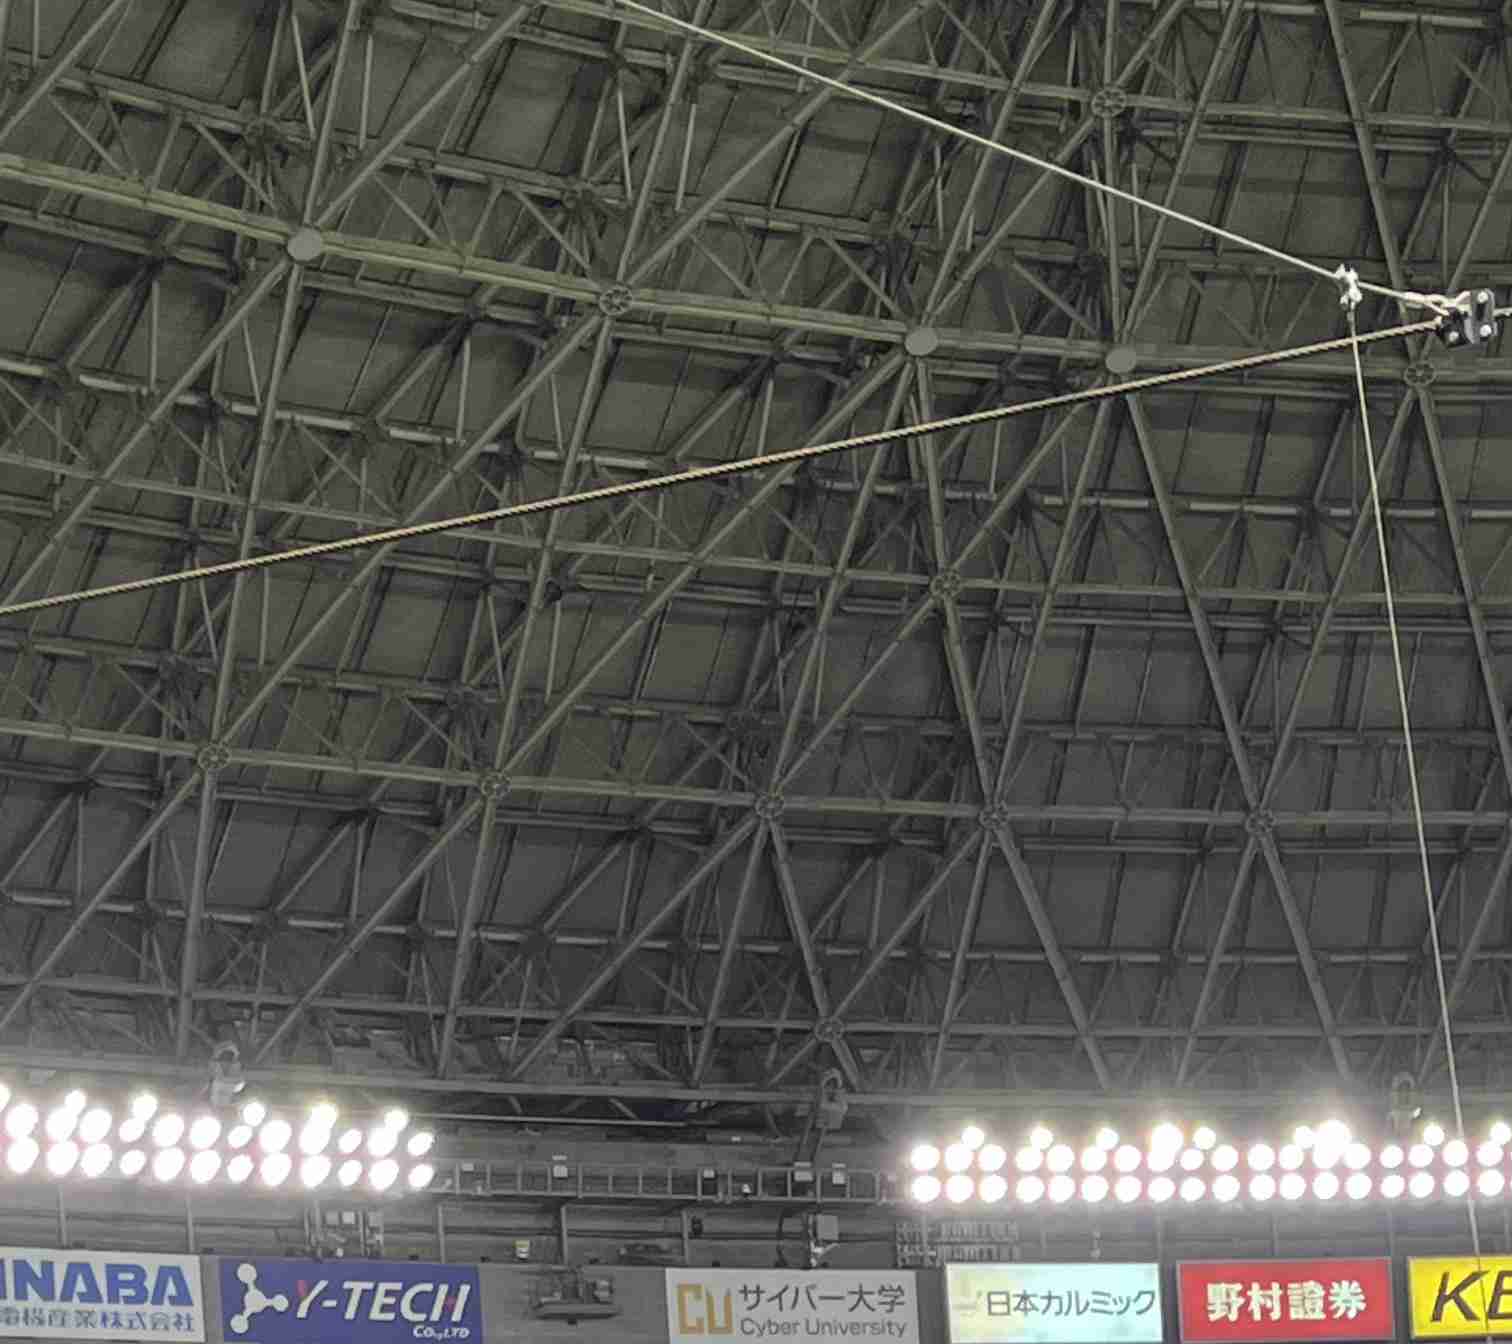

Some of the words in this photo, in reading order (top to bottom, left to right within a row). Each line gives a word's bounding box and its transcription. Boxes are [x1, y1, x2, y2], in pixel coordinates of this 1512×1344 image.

[296, 1278, 472, 1323] Y-TECH
[738, 1282, 906, 1314] サイバー大学
[986, 1289, 1156, 1318] 日本カルミック
[1205, 1279, 1367, 1323] 野村證券
[739, 1317, 800, 1339] Cyber
[805, 1316, 907, 1339] University
